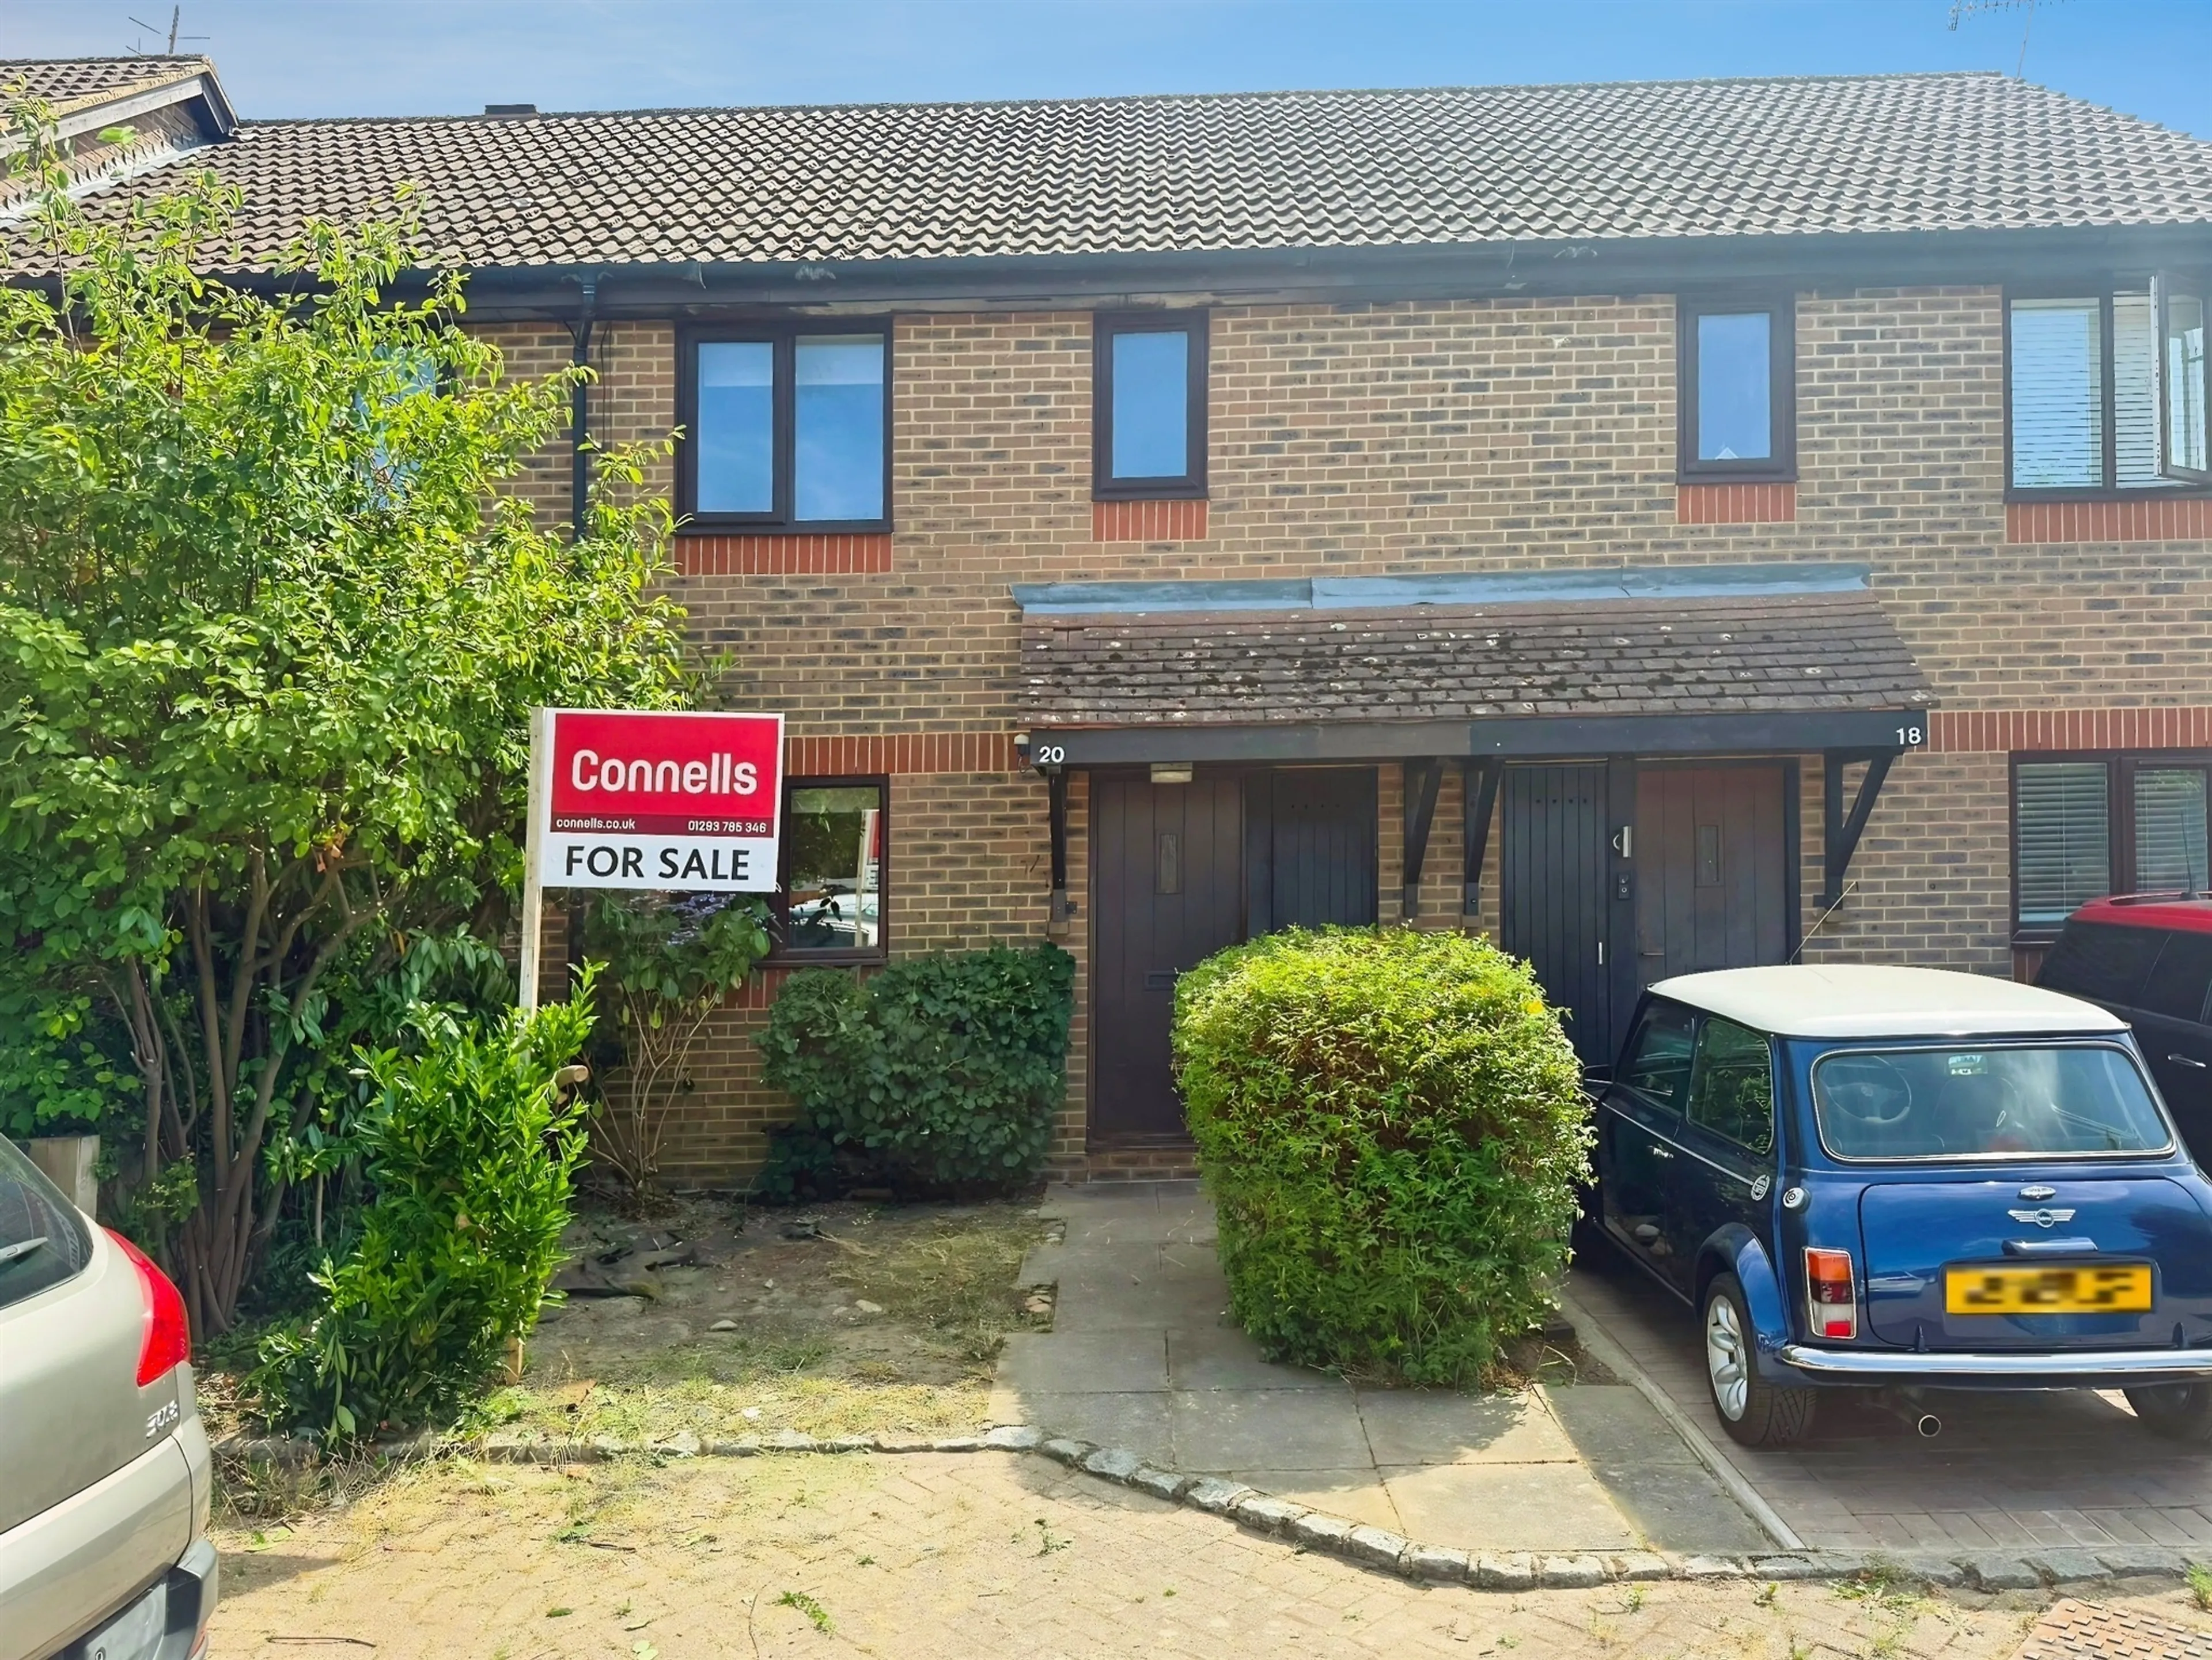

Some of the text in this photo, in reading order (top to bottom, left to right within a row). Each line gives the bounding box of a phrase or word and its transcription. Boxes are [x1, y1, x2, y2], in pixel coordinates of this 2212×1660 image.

[1896, 727, 1922, 745] 18
[1039, 746, 1065, 763] 20
[572, 749, 757, 795] Connells
[556, 818, 635, 830] connells.co.uk
[688, 820, 719, 831] 01293
[745, 822, 767, 833] 346
[566, 845, 750, 880] FOR SALE
